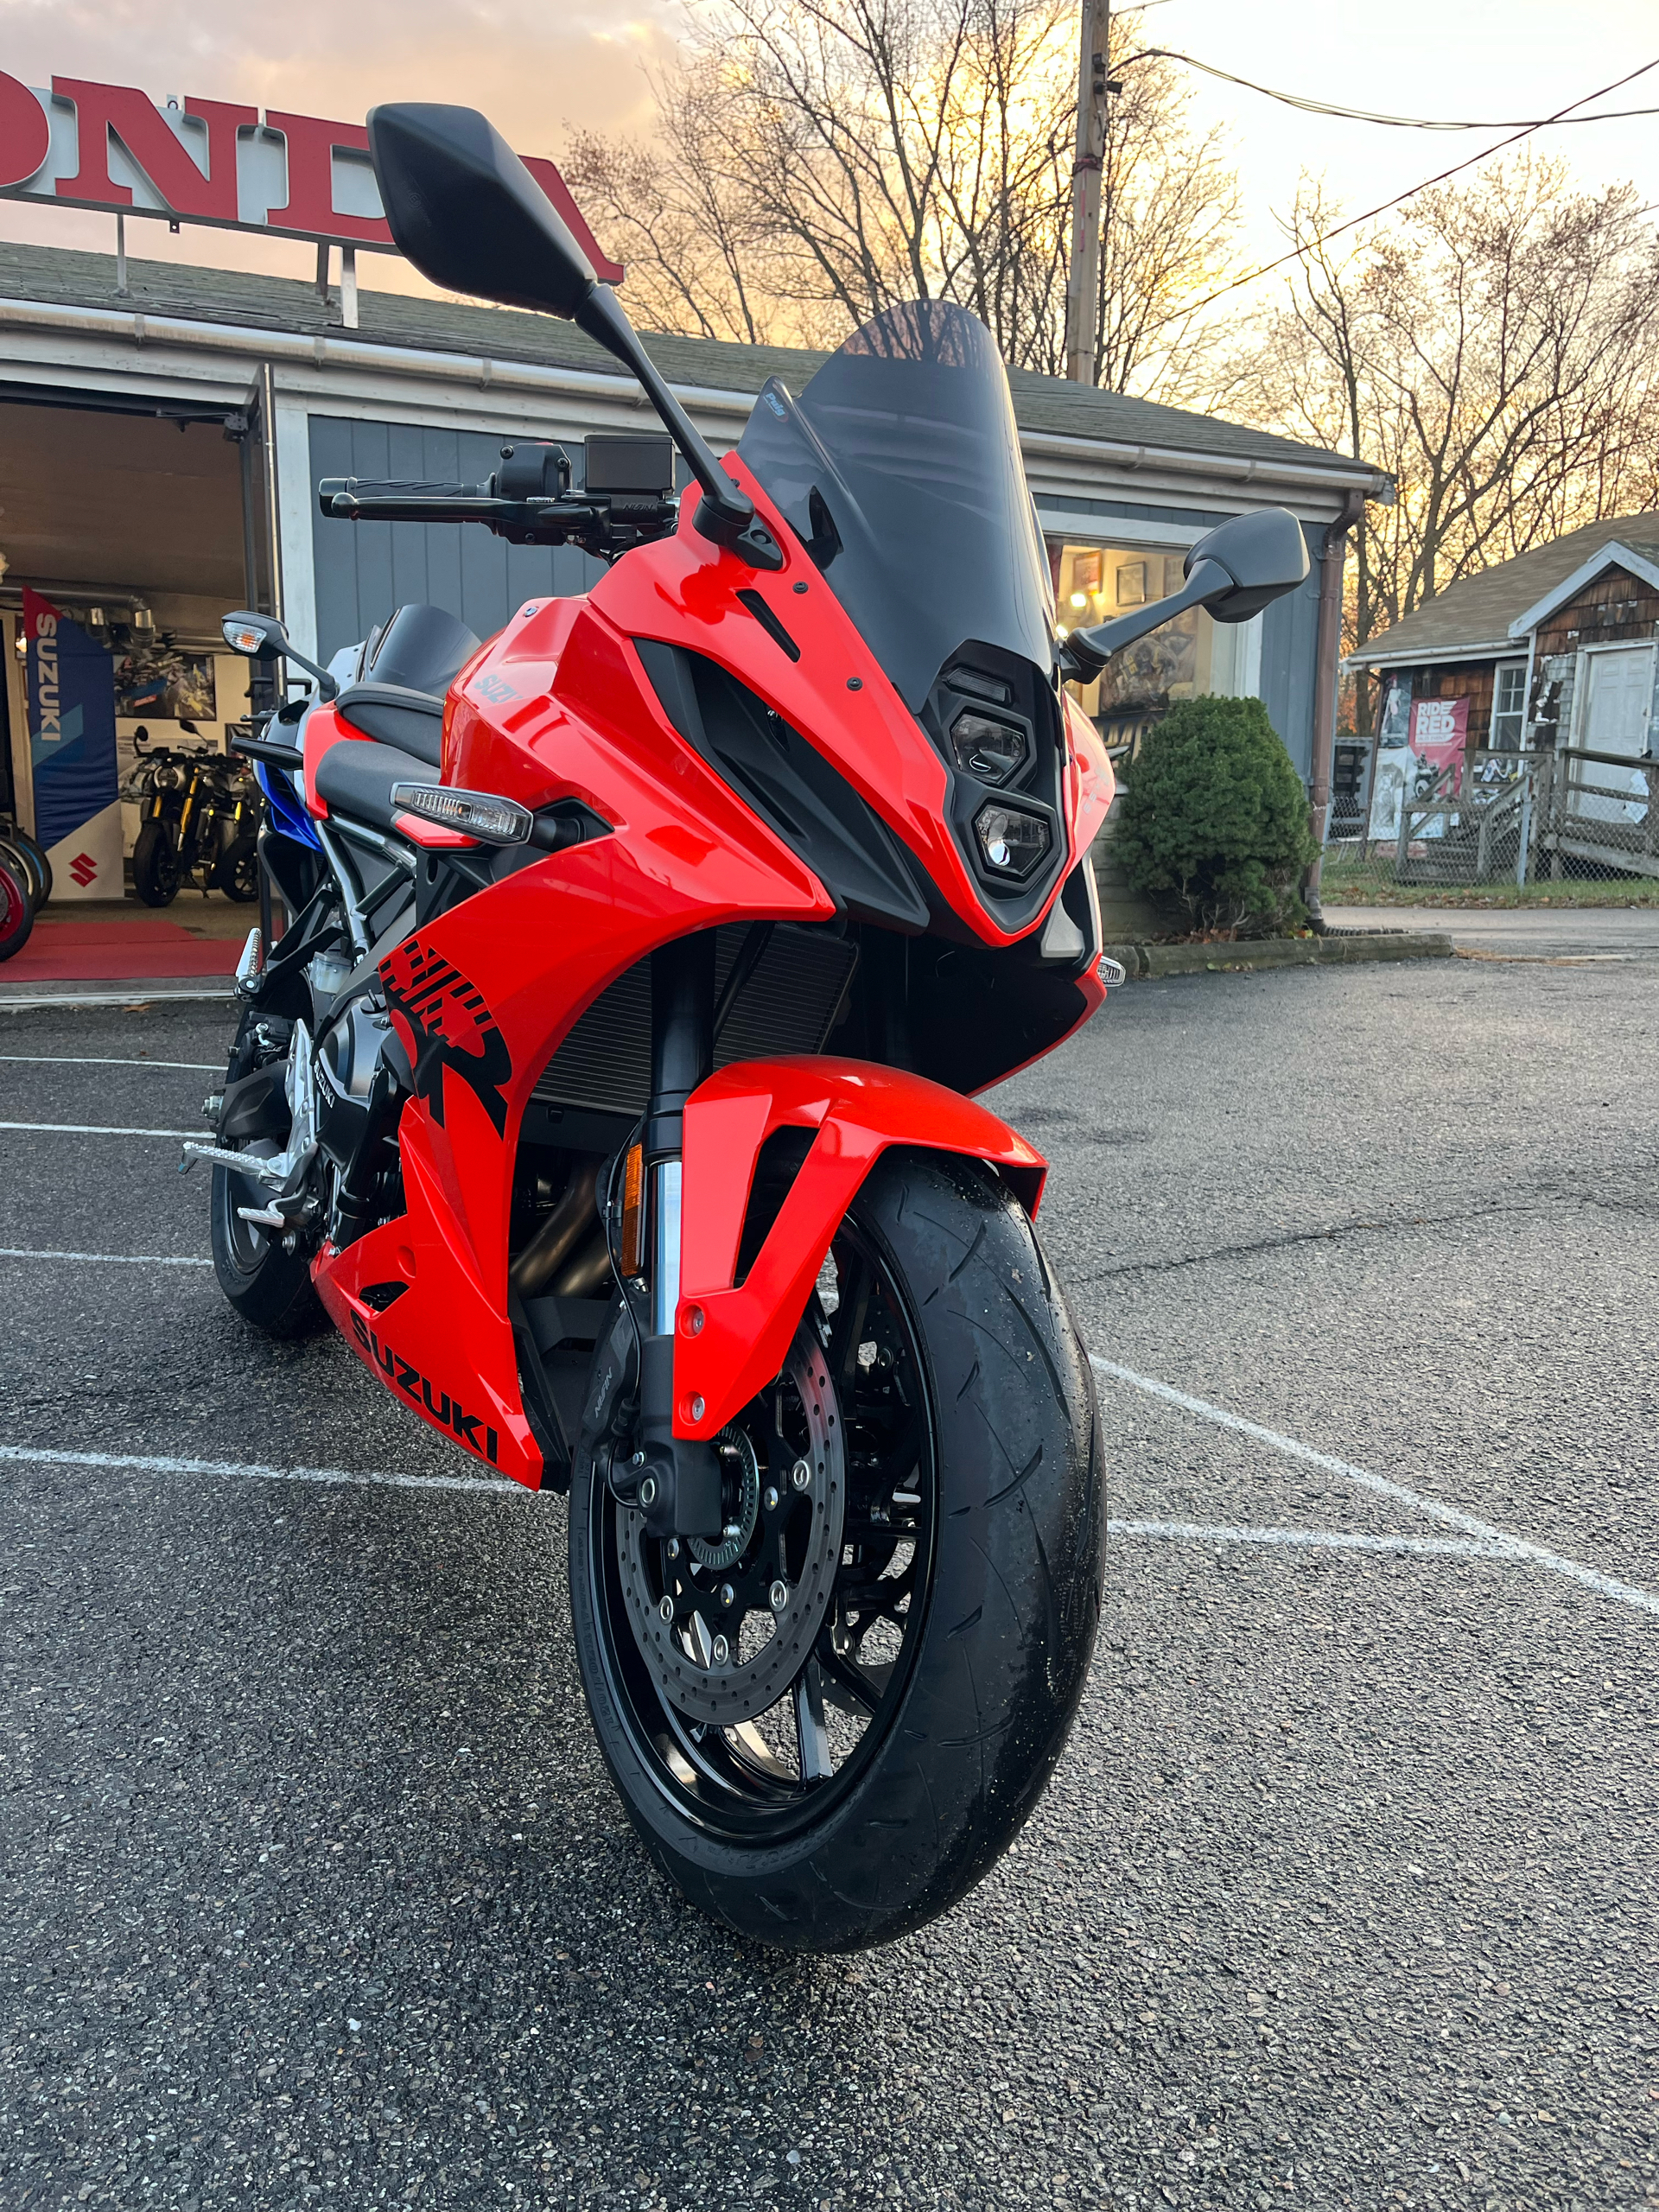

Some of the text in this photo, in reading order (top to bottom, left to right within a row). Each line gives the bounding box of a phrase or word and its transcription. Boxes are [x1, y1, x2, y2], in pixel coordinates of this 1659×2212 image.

[765, 392, 785, 416] Puig
[35, 613, 61, 741] SUZUKI
[1415, 715, 1456, 734] RED
[1418, 700, 1458, 715] RIDE
[315, 1059, 335, 1109] SUZUKI
[350, 1307, 499, 1465] SUZUKI
